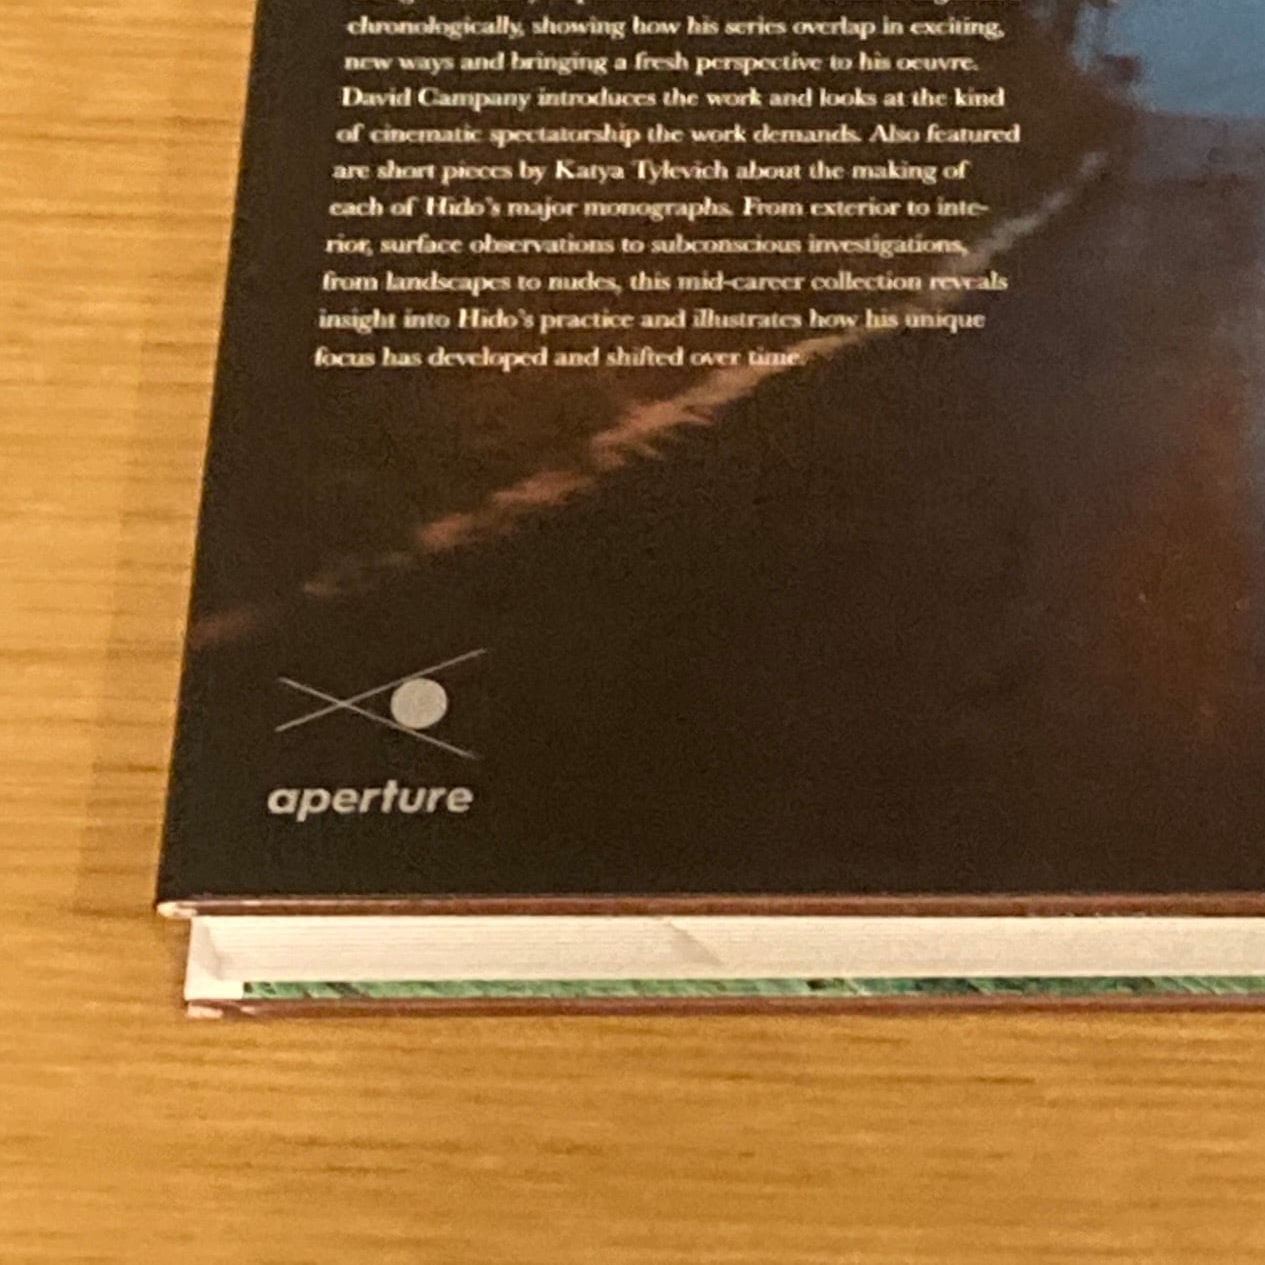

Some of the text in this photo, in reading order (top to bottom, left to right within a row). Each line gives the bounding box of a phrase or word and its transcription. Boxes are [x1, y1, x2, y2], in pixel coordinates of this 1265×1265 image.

[531, 15, 627, 40] showing
[631, 15, 682, 35] how
[686, 15, 720, 35] his
[723, 15, 789, 35] series
[791, 15, 878, 41] overlap
[881, 14, 905, 36] in
[343, 56, 394, 71] new
[396, 56, 456, 76] ways
[459, 51, 506, 71] and
[509, 50, 609, 76] bringing
[612, 57, 628, 71] a
[633, 50, 690, 71] fresh
[694, 56, 824, 77] perspective
[829, 54, 854, 71] to
[858, 50, 892, 71] his
[341, 86, 1006, 113] David Campany introduces the work and looks at the kind
[331, 159, 972, 186] are short pieces by Katya Tylevich about the making of
[328, 195, 385, 217] each
[389, 195, 420, 217] of
[506, 201, 580, 222] major
[741, 195, 805, 217] From
[809, 201, 902, 217] exterior
[906, 200, 932, 217] to
[379, 233, 464, 254] surface
[468, 233, 616, 254] observations
[620, 237, 646, 253] to
[648, 233, 803, 254] subconscious
[807, 233, 970, 259] investigations,
[321, 270, 1009, 297] from landscapes to nudes, this mid-career collection reveals
[318, 308, 397, 335] insight
[402, 308, 452, 329] into
[539, 313, 636, 335] practice
[639, 308, 687, 329] and
[691, 307, 803, 329] illustrates
[808, 308, 862, 328] how
[860, 307, 900, 330] his
[904, 313, 987, 334] unique
[313, 345, 377, 368] focus
[380, 346, 424, 367] has
[426, 346, 549, 373] developed
[552, 345, 601, 367] and
[605, 345, 686, 367] shifted
[689, 352, 742, 366] over
[266, 779, 474, 822] aperture
